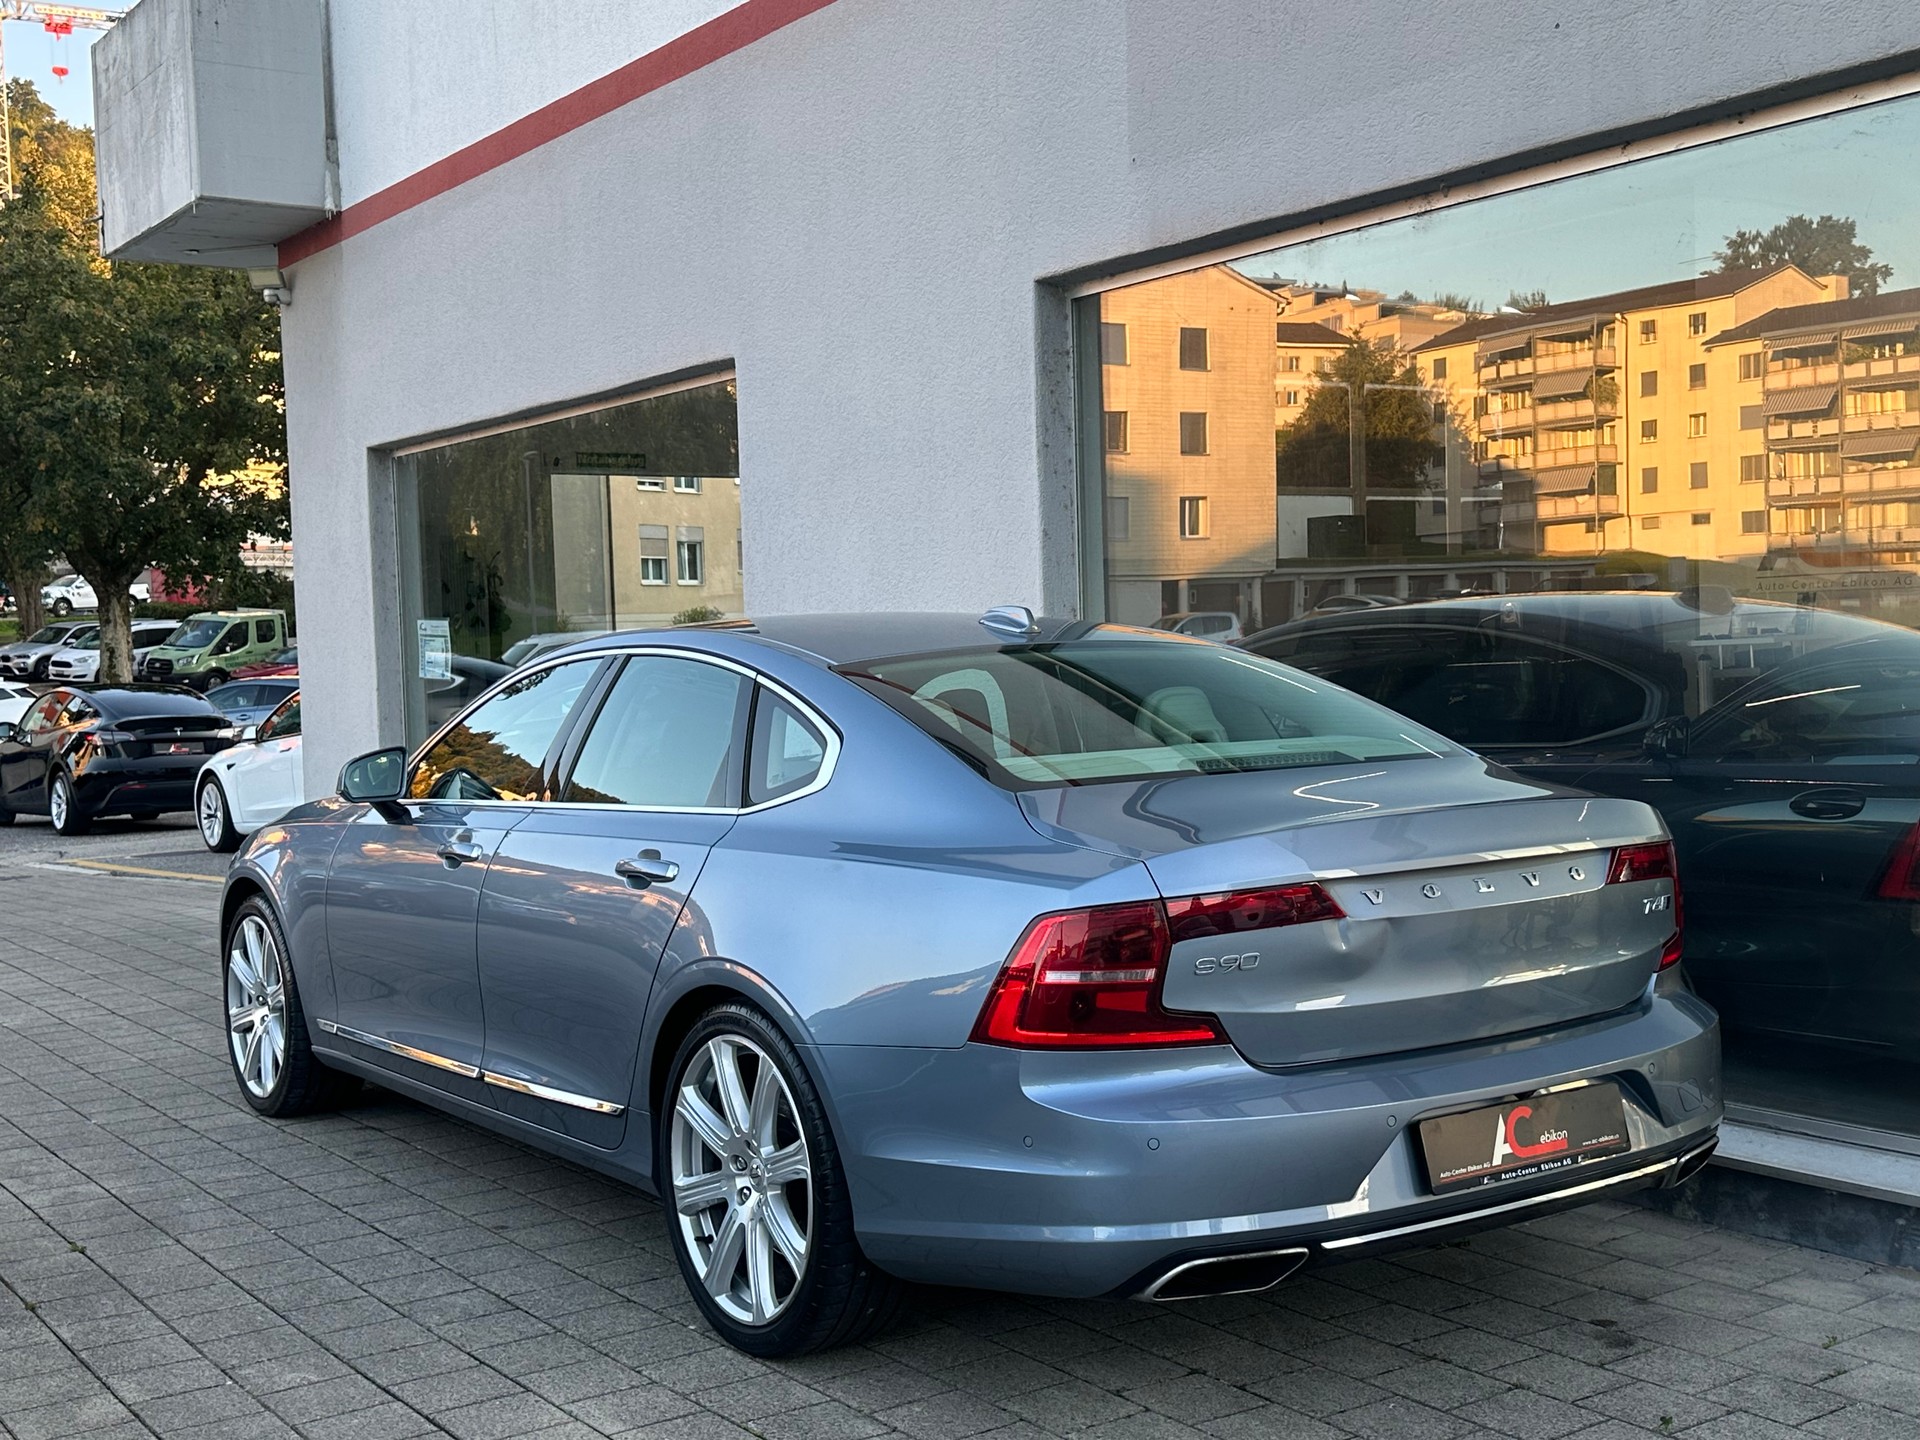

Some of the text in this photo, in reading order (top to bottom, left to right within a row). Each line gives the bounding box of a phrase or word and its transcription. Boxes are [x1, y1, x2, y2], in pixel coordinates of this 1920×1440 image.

[1755, 576, 1913, 592] Auto-Center Ebikon AG
[1360, 866, 1585, 905] VOLVO
[1195, 952, 1260, 975] S90
[1492, 1105, 1568, 1166] AC
[1540, 1129, 1568, 1144] ebikon
[1501, 1166, 1538, 1180] Auto-Center
[1541, 1160, 1561, 1171] Ebikon
[1563, 1158, 1572, 1166] AG
